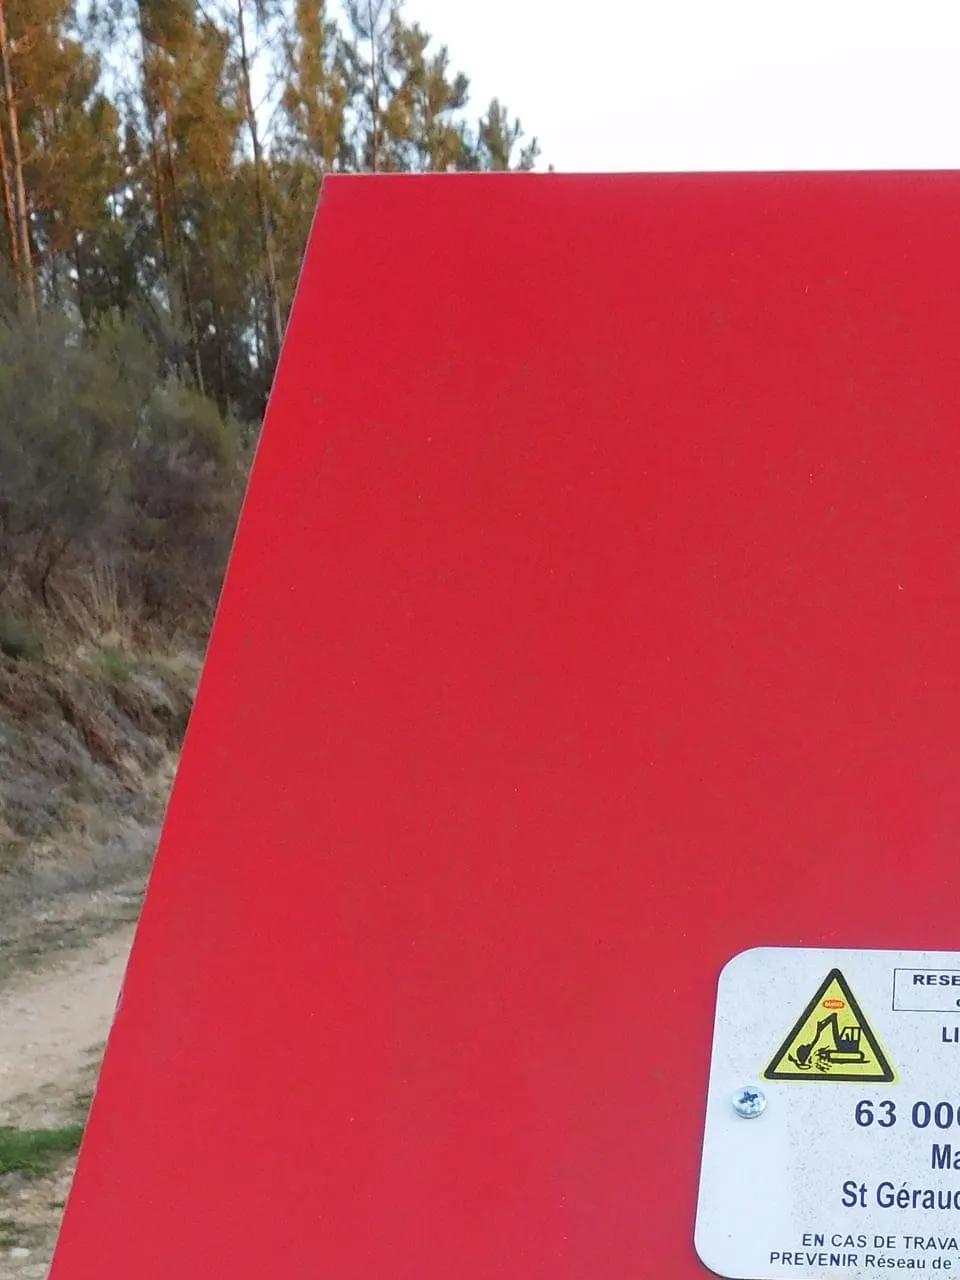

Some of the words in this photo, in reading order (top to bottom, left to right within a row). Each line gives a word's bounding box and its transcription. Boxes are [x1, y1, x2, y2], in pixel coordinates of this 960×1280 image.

[855, 1100, 896, 1127] 63
[842, 1181, 867, 1208] St
[802, 1234, 824, 1246] EN
[832, 1234, 867, 1248] CAS
[874, 1236, 896, 1248] DE
[770, 1252, 857, 1267] PREVENIR
[865, 1254, 925, 1269] Réseau
[932, 1257, 951, 1269] de
